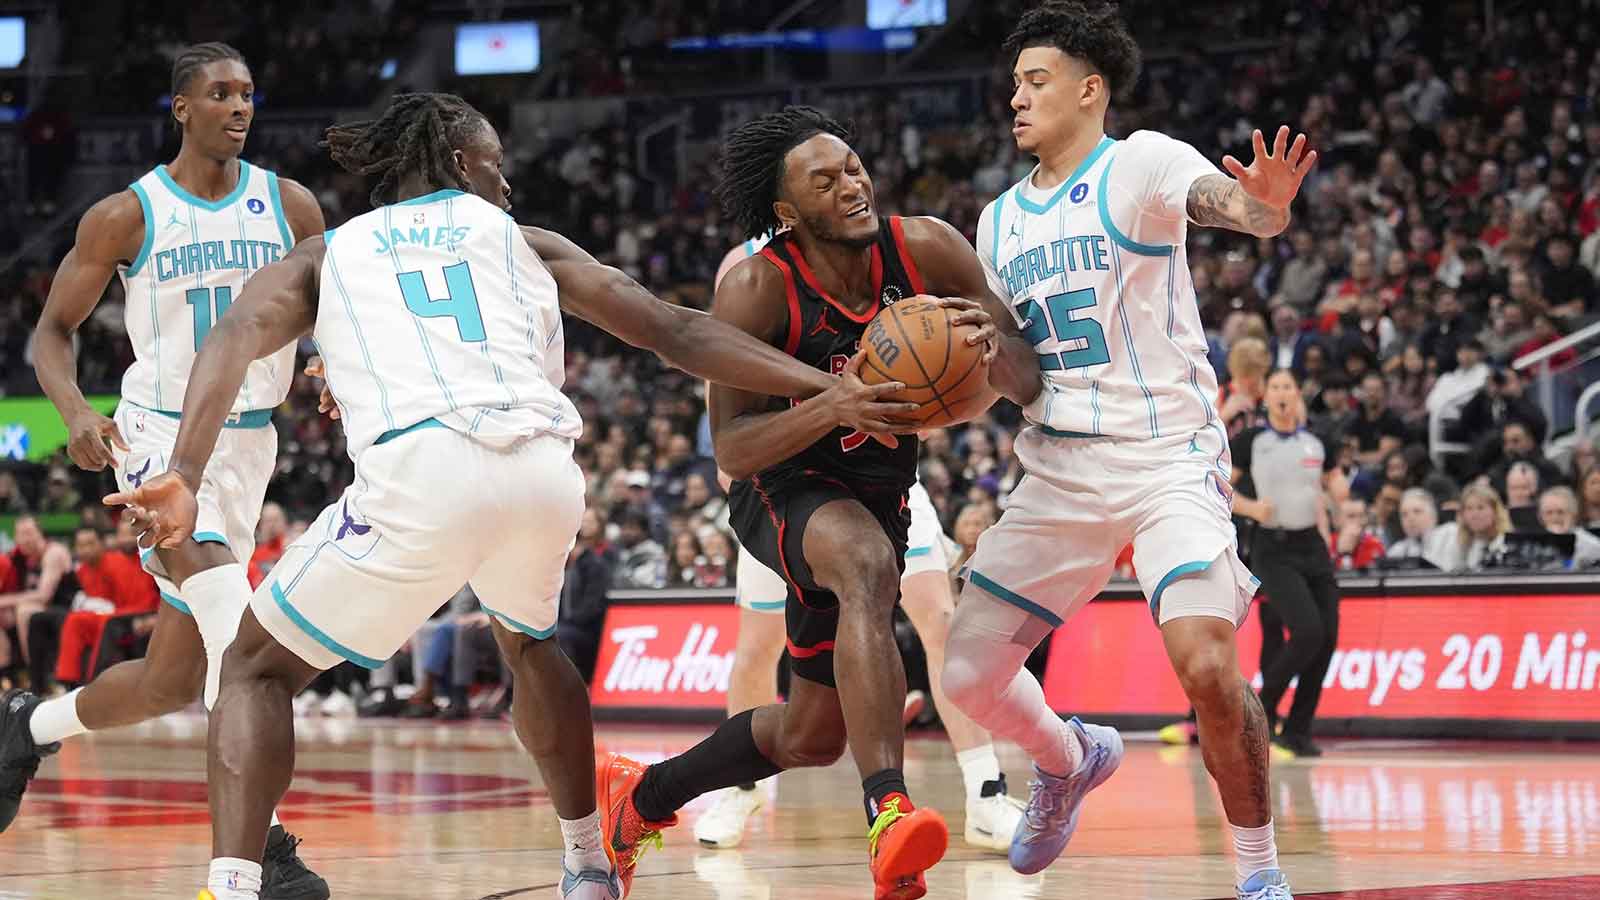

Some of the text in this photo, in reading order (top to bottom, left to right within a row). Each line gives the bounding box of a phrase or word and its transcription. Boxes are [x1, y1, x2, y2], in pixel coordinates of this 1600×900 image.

[155, 239, 284, 282] CHARLOTTE
[372, 226, 471, 253] JAMES
[1000, 235, 1110, 297] HARLOTTE
[396, 260, 488, 343] 4
[1015, 287, 1111, 371] 25
[603, 624, 673, 693] Tim
[1436, 633, 1503, 691] 20
